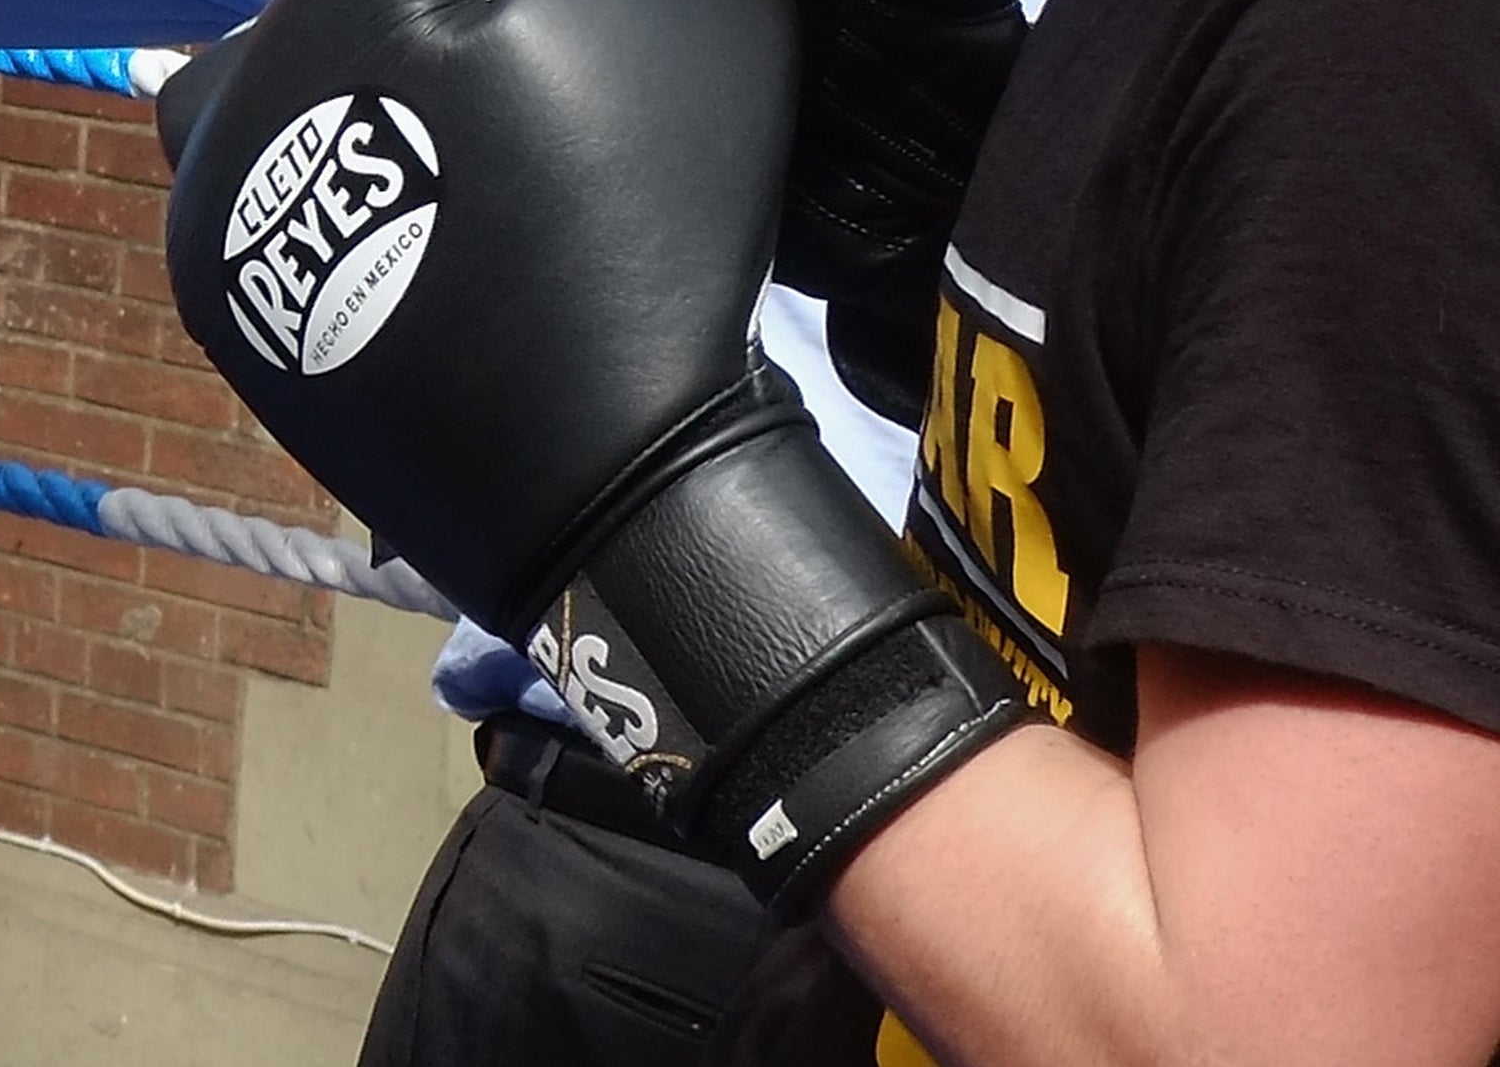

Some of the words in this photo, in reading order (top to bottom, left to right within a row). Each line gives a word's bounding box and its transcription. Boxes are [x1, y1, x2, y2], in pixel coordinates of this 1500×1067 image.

[236, 117, 323, 238] CLETO
[238, 120, 405, 362] REYES
[311, 312, 350, 366] HECHO
[347, 285, 368, 314] EN
[366, 221, 424, 289] MEXICO
